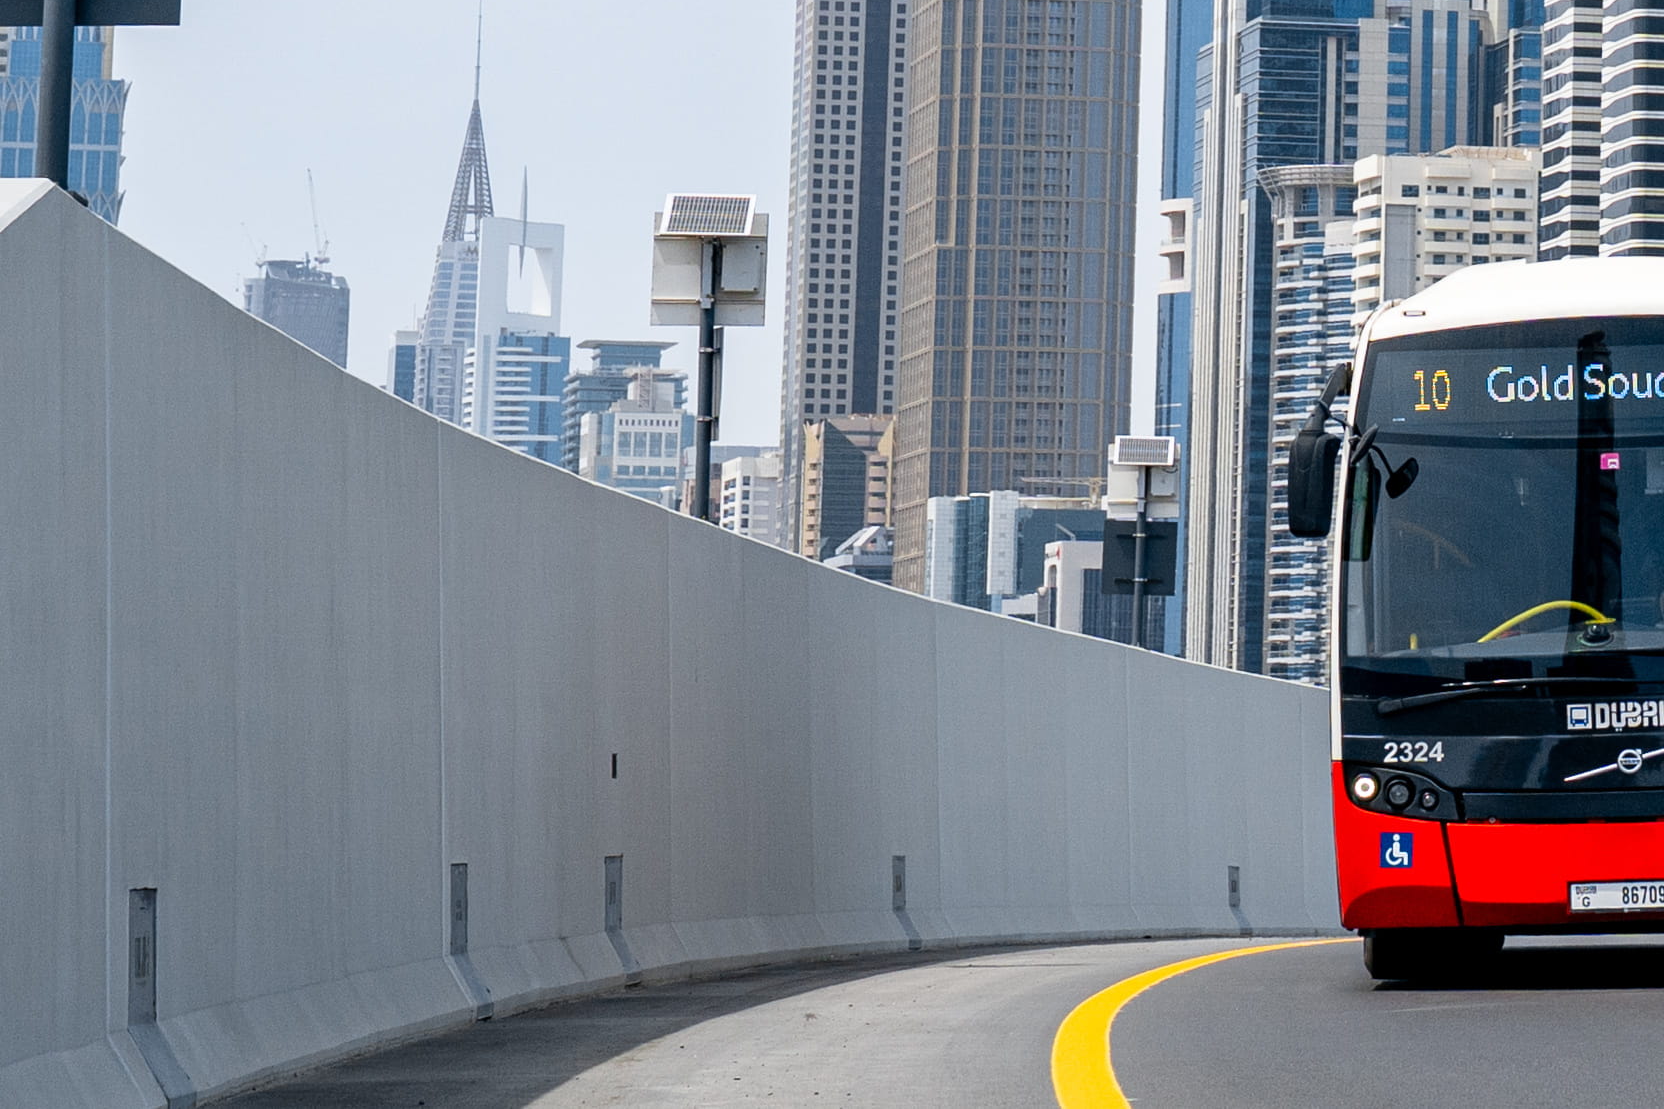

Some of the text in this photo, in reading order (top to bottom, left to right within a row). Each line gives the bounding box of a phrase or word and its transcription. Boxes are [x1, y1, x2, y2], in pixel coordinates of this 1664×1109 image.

[1414, 370, 1451, 411] 10
[1487, 365, 1573, 403] Gold
[1594, 701, 1664, 732] DUBAI
[1383, 741, 1445, 763] 2324
[1582, 896, 1591, 907] G
